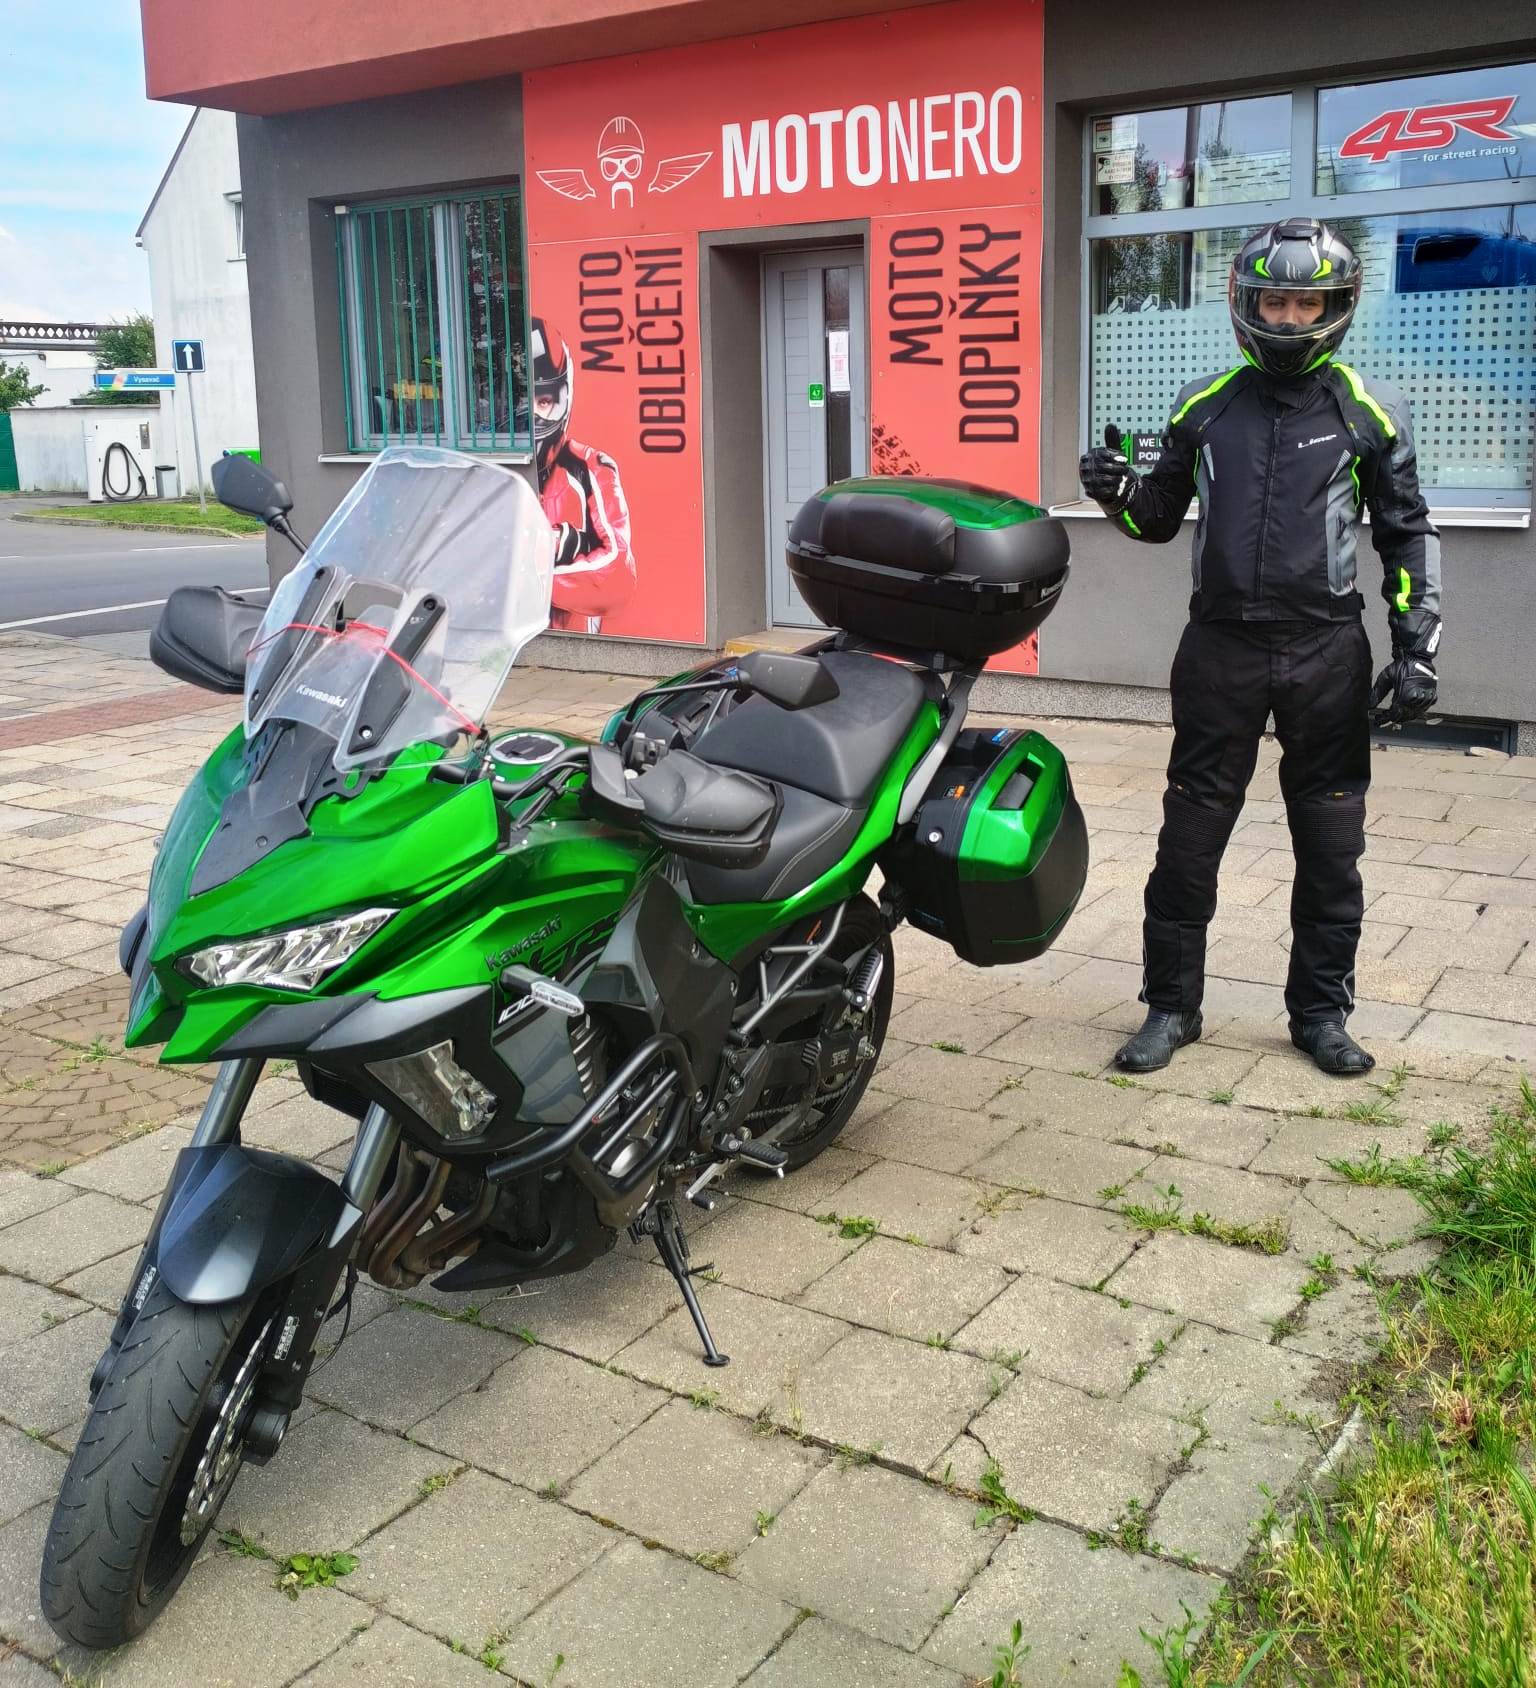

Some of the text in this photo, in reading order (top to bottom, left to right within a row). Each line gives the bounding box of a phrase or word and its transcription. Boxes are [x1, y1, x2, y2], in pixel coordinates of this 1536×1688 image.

[721, 86, 1023, 199] MOTONERO
[1423, 145, 1517, 162] for street racing
[578, 250, 626, 374] MOTO
[626, 245, 687, 454] OBLEČENÍ
[889, 226, 944, 366] MOTO
[948, 223, 1022, 444] DOPLŇKY
[295, 684, 348, 708] Kawasaki
[484, 913, 562, 972] Kawasaki
